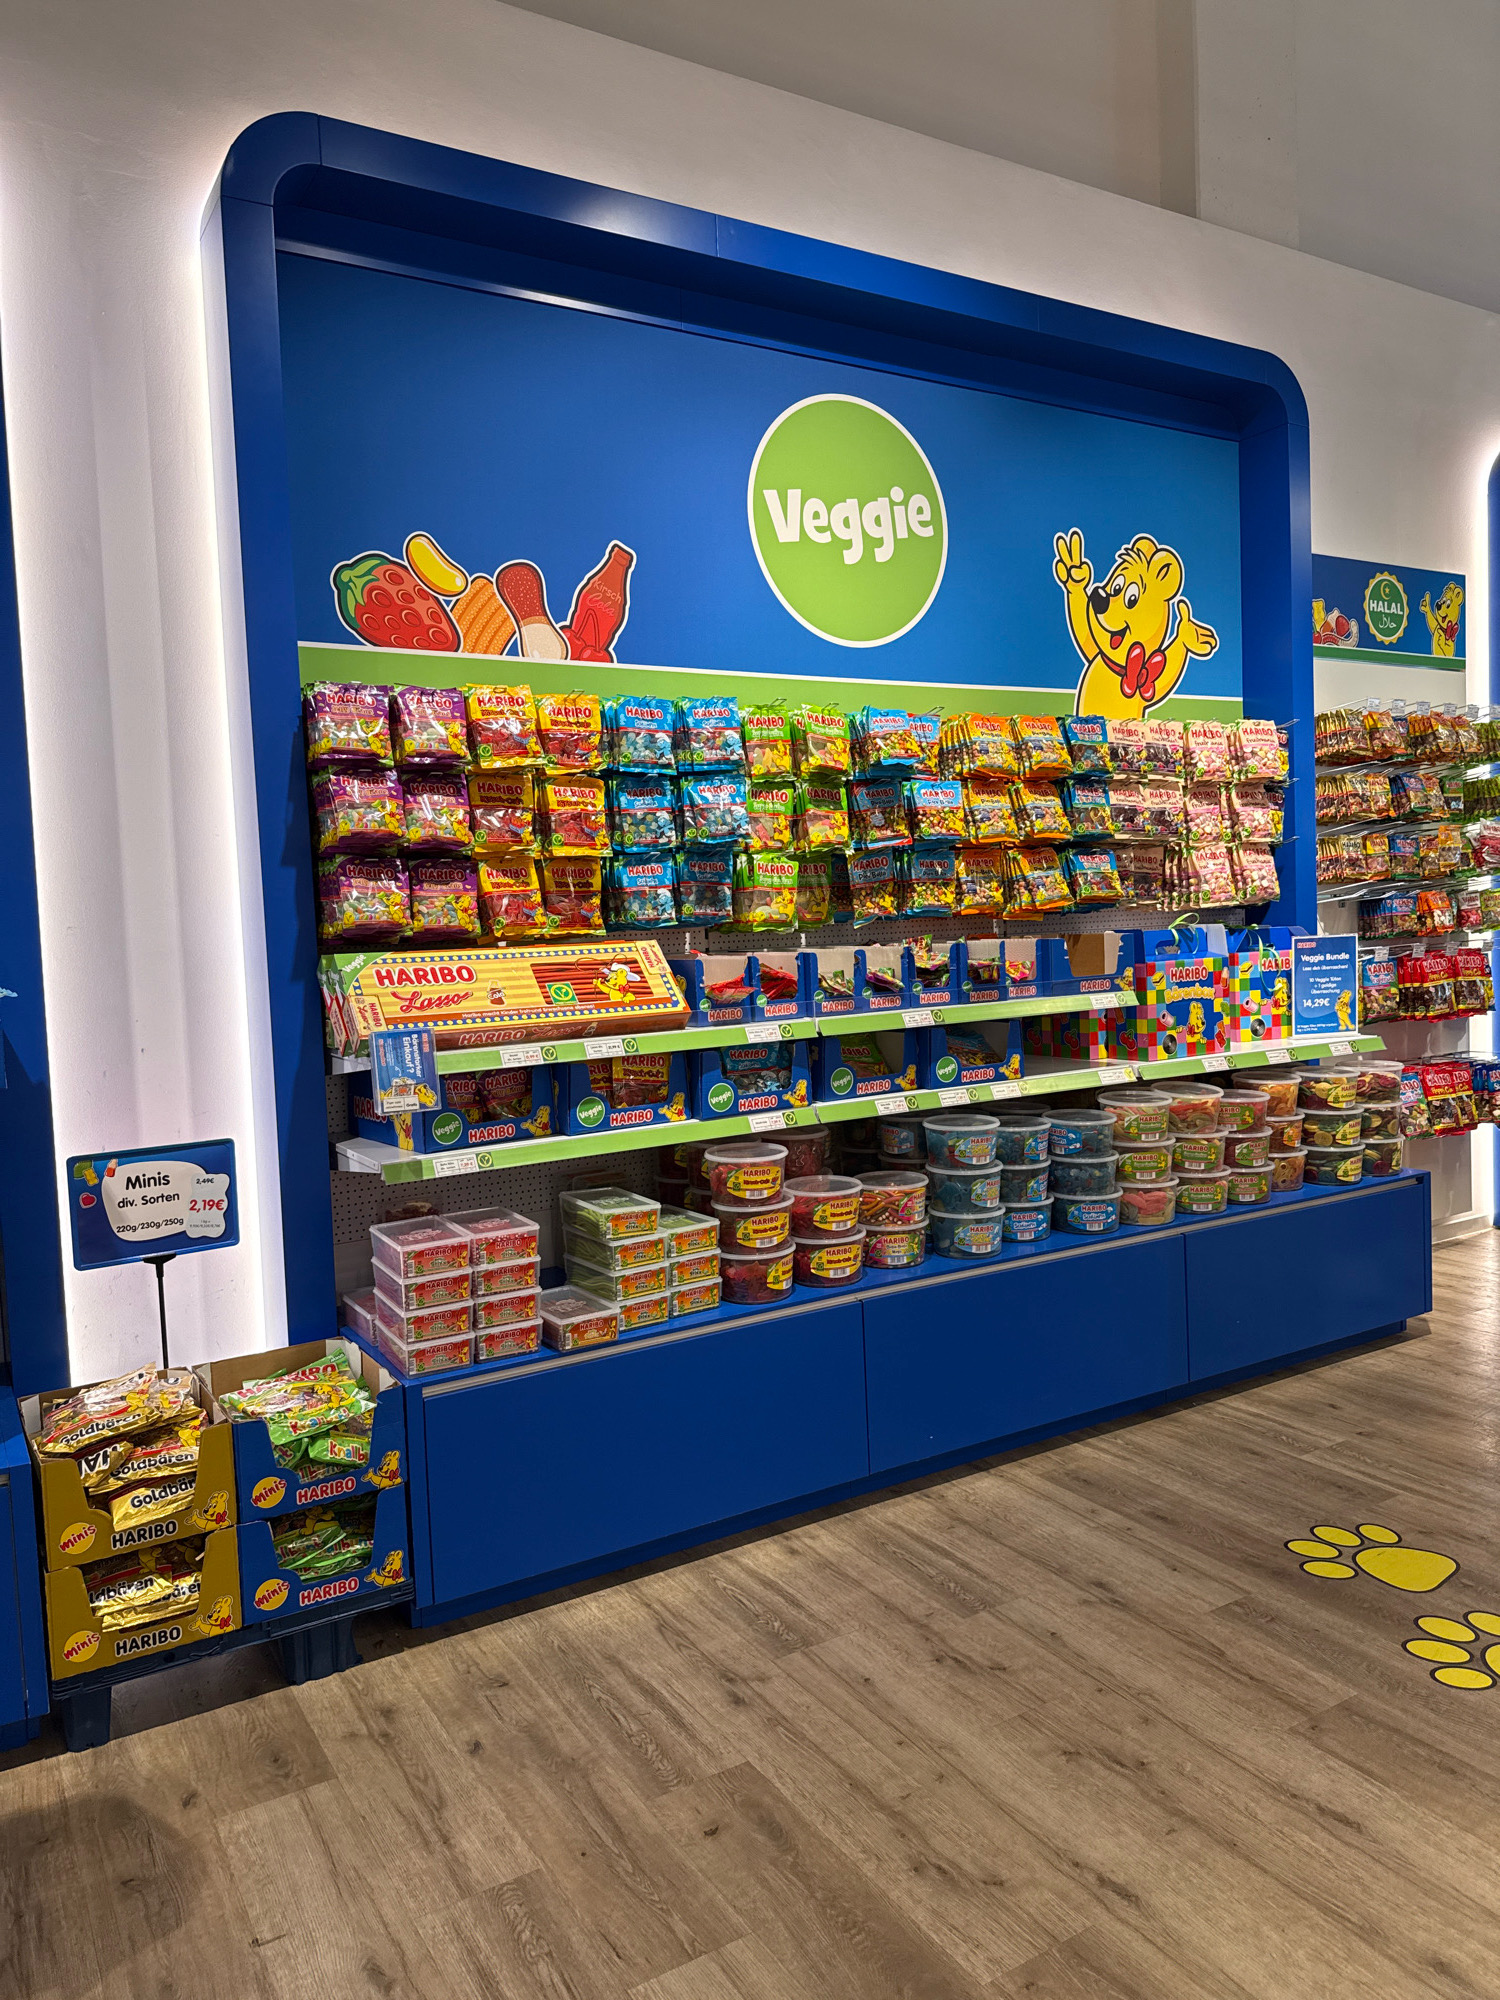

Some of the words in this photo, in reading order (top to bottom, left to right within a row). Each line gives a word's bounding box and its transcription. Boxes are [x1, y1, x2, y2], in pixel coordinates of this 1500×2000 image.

[763, 486, 934, 565] Veggie
[1370, 600, 1403, 615] HALAL
[1379, 614, 1397, 629] حلال
[327, 693, 376, 708] HARIBO
[477, 695, 526, 708] HARIBO
[549, 706, 593, 720] HARIBO
[626, 706, 663, 720] HARIBO
[693, 705, 730, 719] HARIBO
[748, 716, 785, 729] HARIBO
[807, 712, 845, 729] HARIBO
[873, 716, 905, 725] HARIBO
[910, 721, 932, 732] ARIBO
[974, 721, 1001, 732] HARIBO
[1071, 723, 1102, 735] HARIBO
[1111, 726, 1140, 737] HARIBO
[1149, 726, 1176, 737] HARIBO
[1191, 728, 1222, 739] HARIBO
[1241, 727, 1274, 737] HARIBO
[341, 775, 389, 788] HARIBO
[411, 783, 457, 796] HARIBO
[477, 782, 524, 796] HARIBO
[554, 786, 598, 800] HARIBO
[626, 788, 663, 799] HARIBO
[751, 788, 789, 804] HARIBO
[807, 787, 842, 801] HARIBO
[865, 788, 895, 799] HARIBO
[921, 789, 955, 799] HARIBO
[1149, 790, 1177, 800] HARIBO
[627, 865, 664, 877] HARIBO
[689, 861, 726, 873] HARIBO
[757, 862, 795, 876] HARIBO
[799, 863, 827, 876] ARIBO
[852, 857, 889, 873] HARIBO
[919, 859, 949, 870] HARIBO
[346, 864, 394, 880] HARIBO
[418, 868, 465, 883] HARIBO
[486, 868, 528, 880] HARIBO
[551, 868, 594, 880] HARIBO
[342, 954, 367, 973] Veggie
[641, 946, 656, 969] HARIBO
[1300, 955, 1325, 964] Veggie
[1326, 952, 1350, 961] Bundle
[1258, 958, 1292, 974] HARIB
[374, 965, 477, 988] HARIBO
[1169, 966, 1209, 983] HARIBO
[1009, 986, 1038, 998] HARIBO
[1081, 979, 1112, 993] HARIBO
[920, 991, 951, 1004] HARIBO
[970, 990, 1001, 1003] HARIBO
[1164, 982, 1216, 1005] Bärenbox
[390, 991, 473, 1014] Lasso
[821, 1000, 855, 1012] HARIBO
[869, 996, 903, 1010] HARIBO
[1303, 998, 1331, 1008] 14,29€
[369, 1002, 383, 1028] HARIBO
[708, 1008, 743, 1022] HARIBO
[765, 1003, 799, 1017] HARIBO
[458, 1029, 527, 1046] HARIBO
[530, 1025, 582, 1039] Lasso
[411, 1033, 422, 1078] Bärenstarker
[729, 1049, 769, 1061] HARIBO
[620, 1056, 666, 1071] HARIBO
[937, 1062, 957, 1077] Veggie
[486, 1069, 528, 1091] HARIBO
[961, 1068, 996, 1083] HARIBO
[832, 1077, 853, 1091] Veggie
[856, 1083, 892, 1098] HARIBO
[710, 1090, 732, 1105] Veggie
[738, 1095, 780, 1112] HARIBO
[579, 1103, 603, 1120] Veggie
[1220, 1106, 1240, 1114] ARIBO
[610, 1108, 654, 1127] HARIBO
[435, 1121, 461, 1138] Veggie
[467, 1125, 516, 1144] HARIBO
[1183, 1144, 1209, 1152] HARIBO
[743, 1168, 771, 1177] HARIBO
[125, 1172, 171, 1191] Minis
[195, 1177, 215, 1187] 2,49€
[117, 1197, 138, 1210] div.
[141, 1193, 180, 1207] Sorten
[189, 1199, 225, 1213] 2,19€
[830, 1200, 854, 1210] HARIBO
[1081, 1204, 1106, 1212] HARIBO
[620, 1212, 644, 1221] HARIBO
[751, 1215, 780, 1225] HARIBO
[1011, 1213, 1037, 1221] HARIBO
[116, 1217, 184, 1235] 220g/230g/250g
[969, 1225, 994, 1233] HARIBO
[683, 1230, 704, 1240] HARIBO
[883, 1236, 910, 1245] HARIBO
[495, 1239, 522, 1250] HARIBO
[628, 1242, 651, 1252] HARIBO
[825, 1246, 853, 1257] HARIBO
[424, 1247, 453, 1259] HARIBO
[685, 1258, 706, 1268] HARIBO
[493, 1265, 520, 1277] HARIBO
[630, 1271, 652, 1282] HARIBO
[425, 1279, 454, 1290] HARIBO
[685, 1288, 707, 1297] HARIBO
[493, 1298, 521, 1309] HARIBO
[632, 1301, 655, 1312] HARIBO
[424, 1312, 453, 1323] HARIBO
[579, 1319, 604, 1331] HARIBO
[495, 1330, 521, 1341] HARIBO
[425, 1343, 454, 1356] HARIBO
[60, 1412, 142, 1446] Goldbären
[328, 1440, 366, 1462] Knallb
[131, 1477, 196, 1508] Goldbär
[251, 1478, 288, 1506] minis
[296, 1477, 356, 1506] HARIBO
[60, 1524, 97, 1552] minis
[112, 1520, 178, 1550] HARIBO
[90, 1576, 155, 1605] ldbären
[254, 1581, 289, 1609] minis
[299, 1577, 360, 1607] HARIBO
[63, 1632, 100, 1661] minis
[115, 1625, 183, 1658] HARIBO
